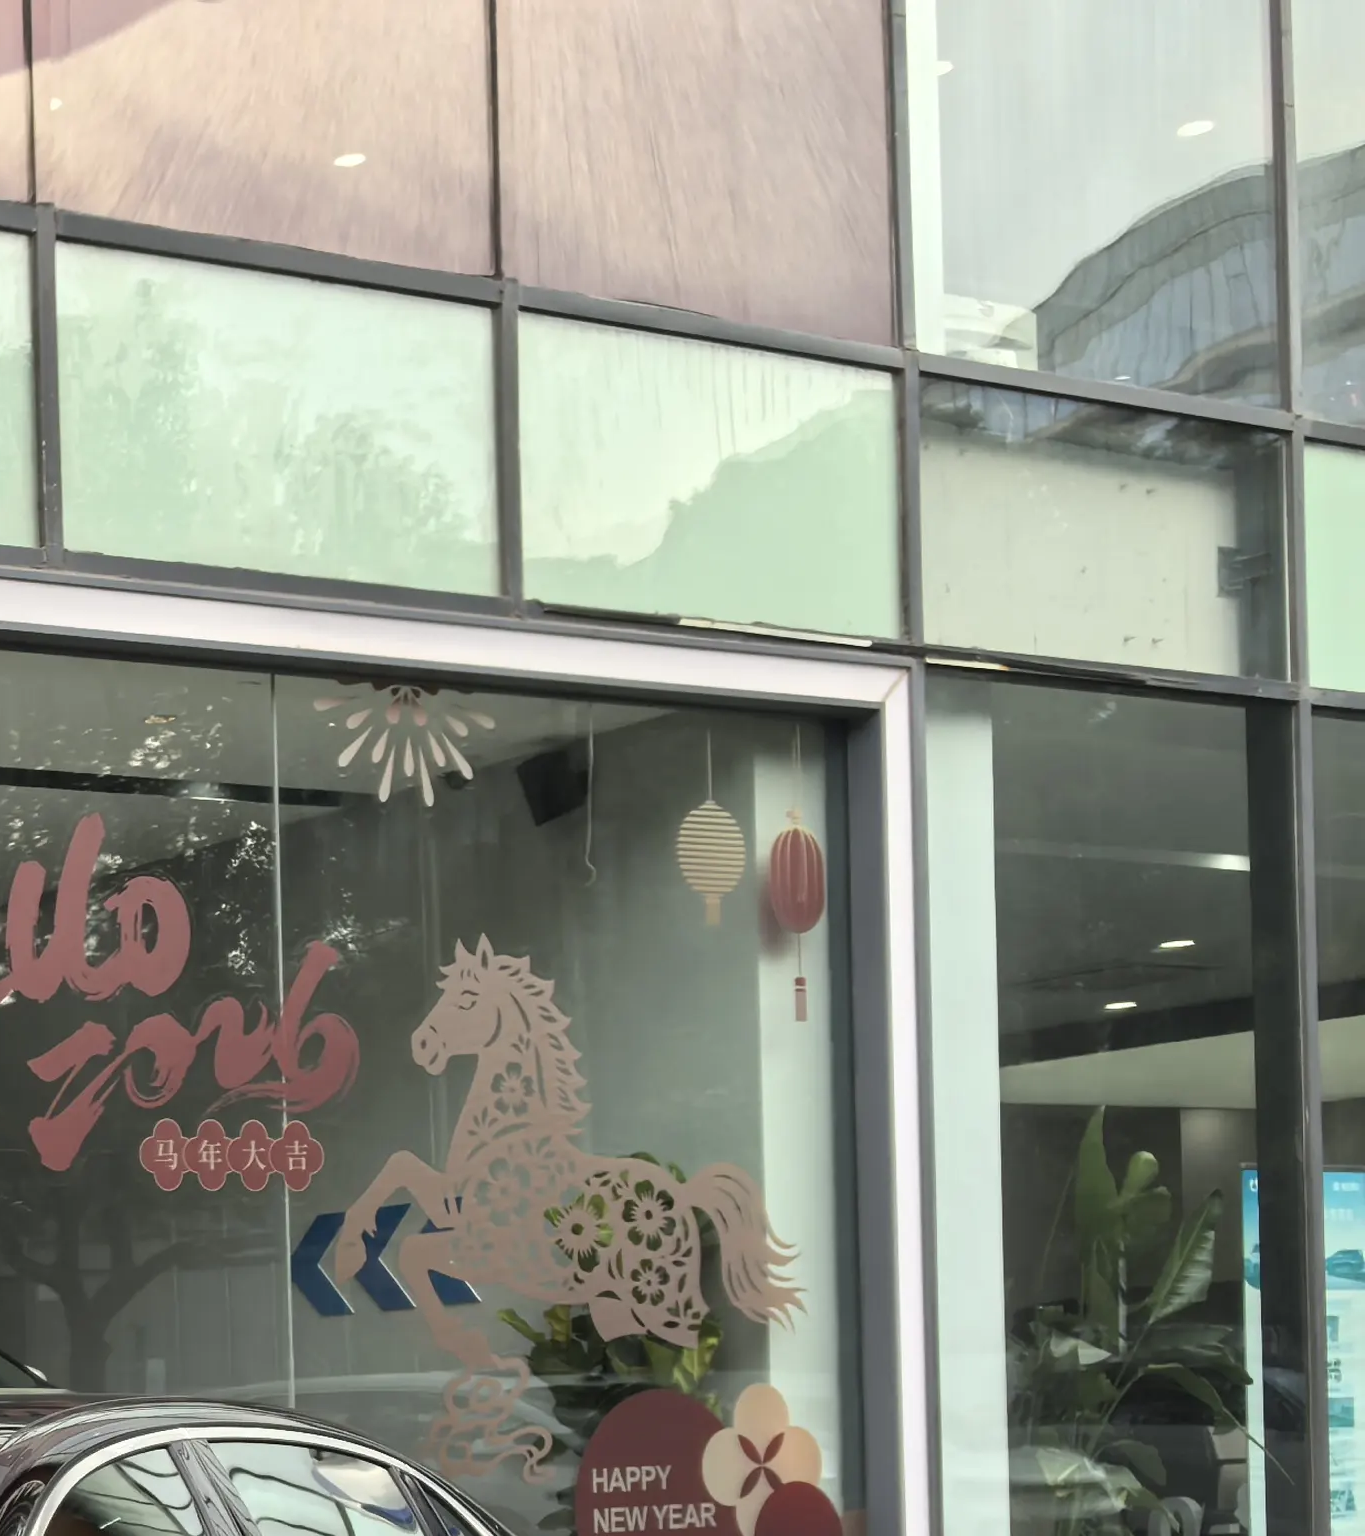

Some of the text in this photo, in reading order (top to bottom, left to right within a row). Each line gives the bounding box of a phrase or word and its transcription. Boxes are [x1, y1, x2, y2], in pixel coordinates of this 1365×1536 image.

[154, 1139, 308, 1171] 马年大吉
[591, 1465, 671, 1494] HAPPY
[593, 1503, 717, 1534] NEW YEAR
